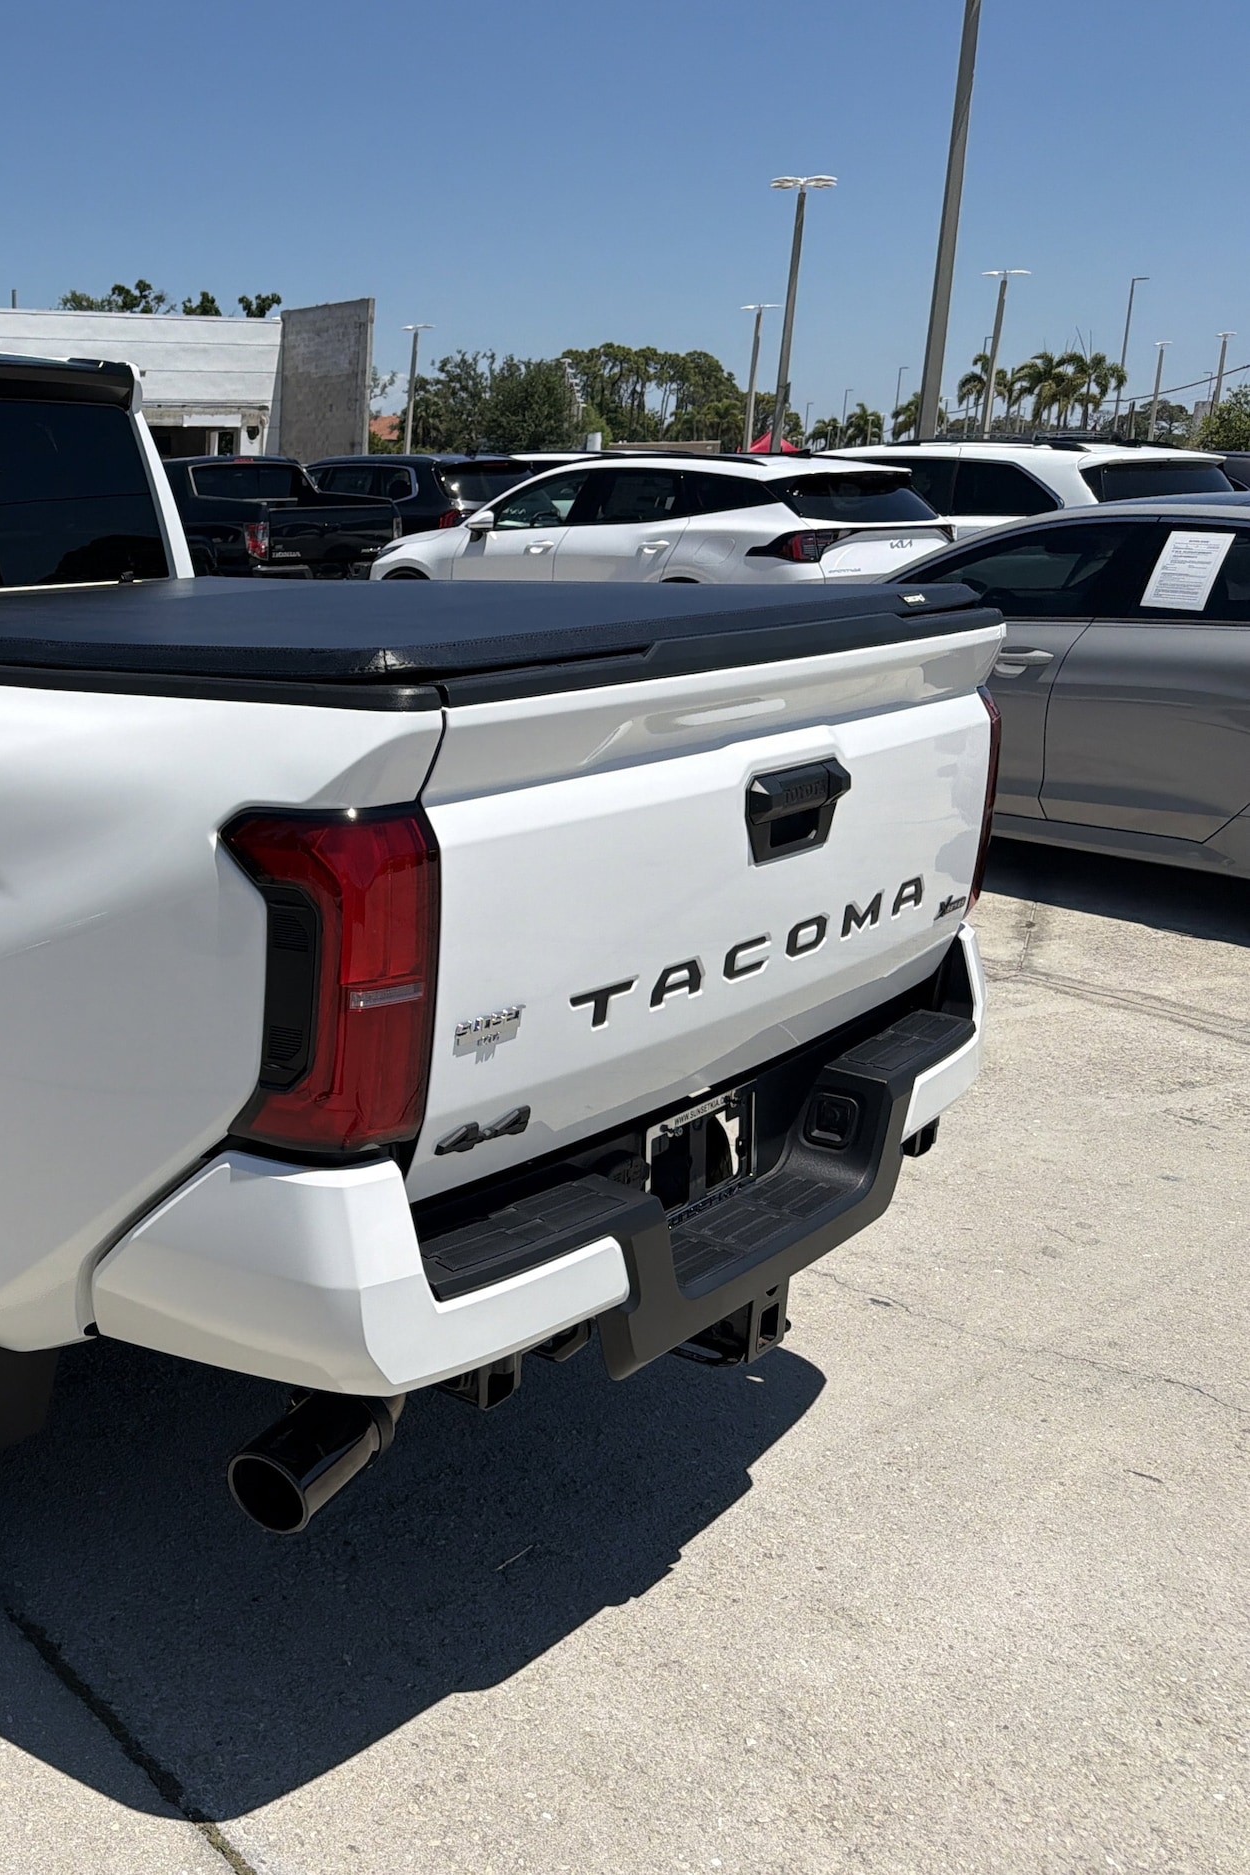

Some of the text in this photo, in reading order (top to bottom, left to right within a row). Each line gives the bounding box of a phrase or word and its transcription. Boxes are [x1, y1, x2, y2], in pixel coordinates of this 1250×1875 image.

[783, 778, 826, 804] TOYOTA
[570, 875, 923, 1030] TACOMA
[674, 1090, 733, 1126] WWW.SUNSETKIA.C
